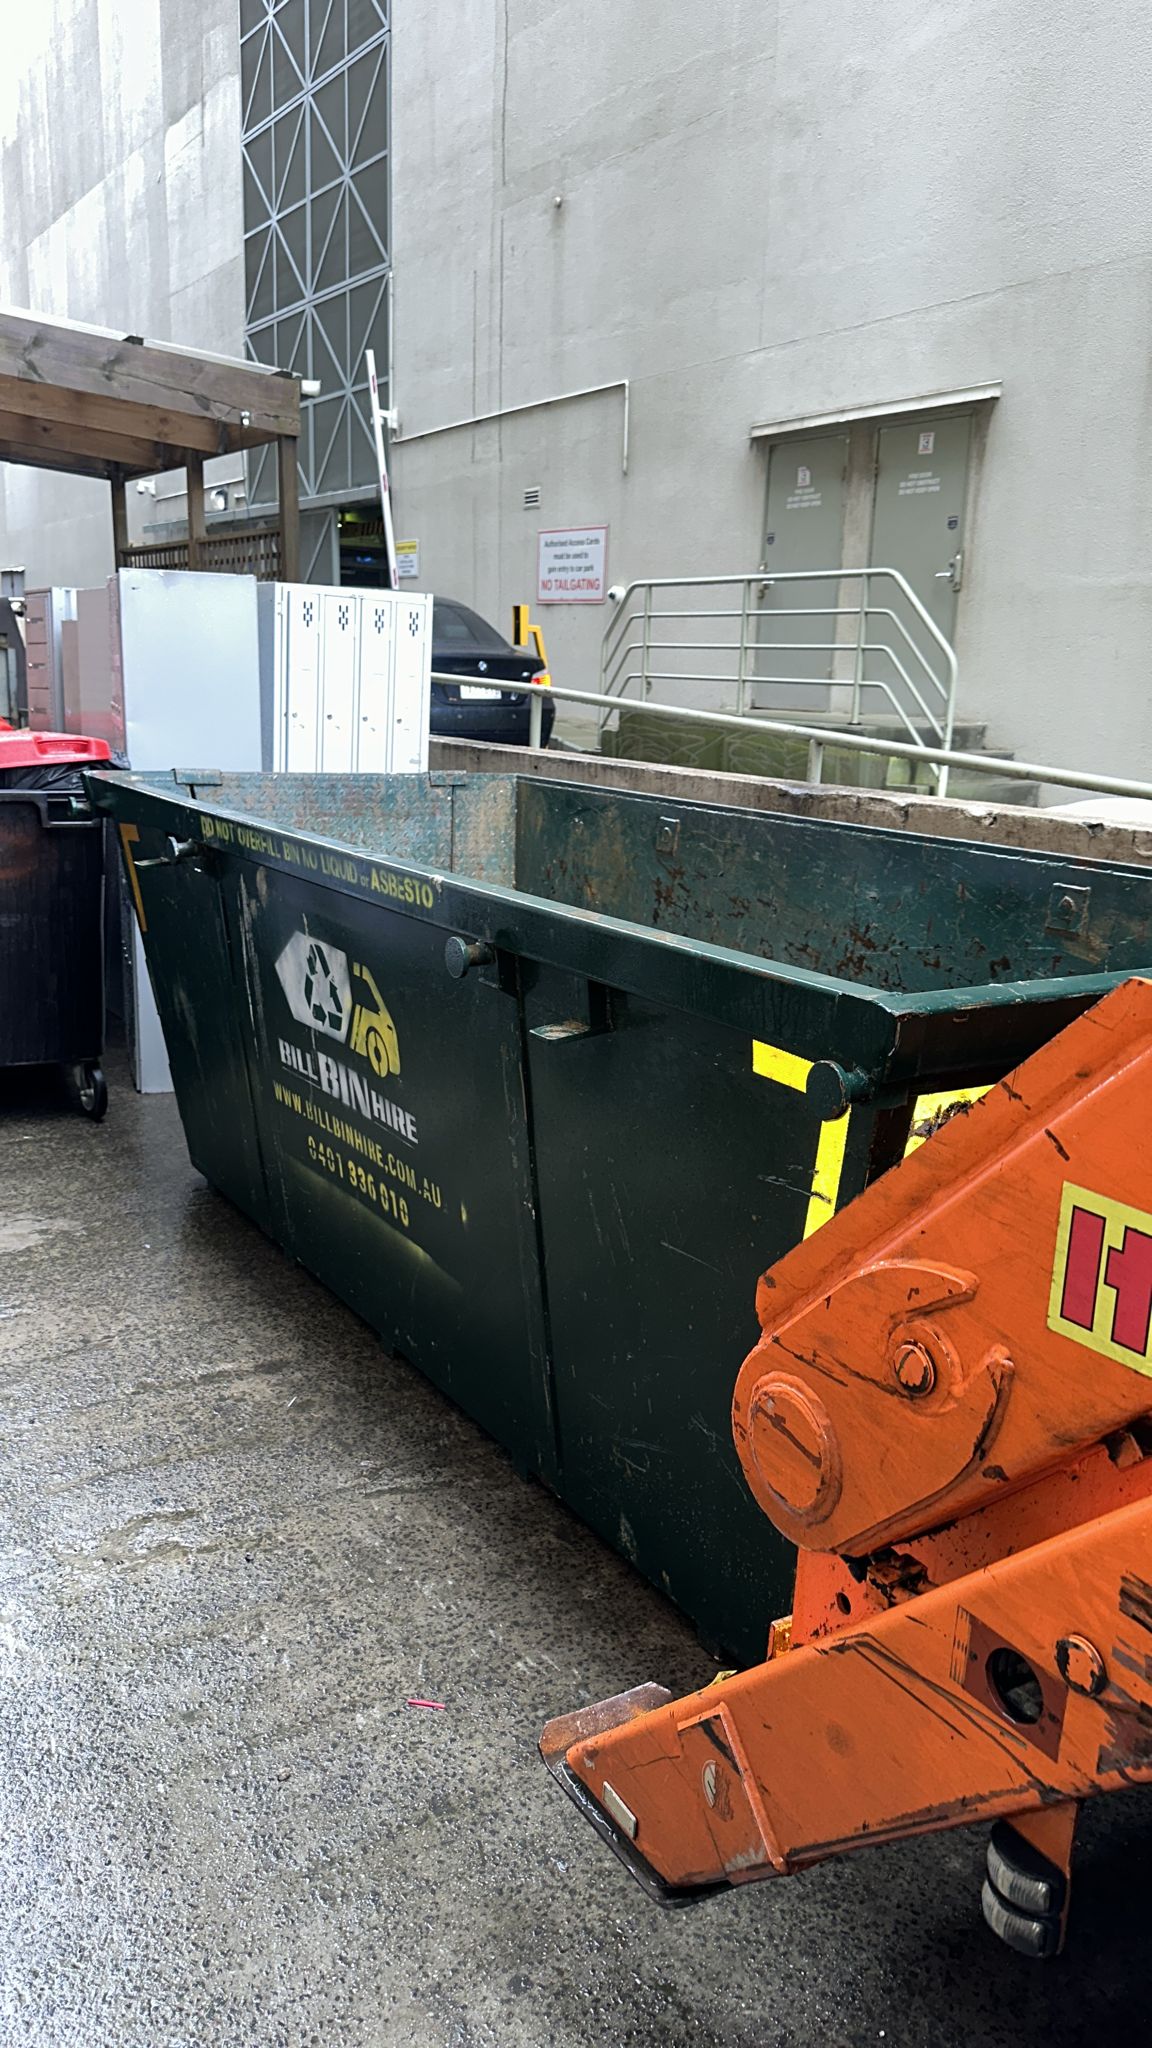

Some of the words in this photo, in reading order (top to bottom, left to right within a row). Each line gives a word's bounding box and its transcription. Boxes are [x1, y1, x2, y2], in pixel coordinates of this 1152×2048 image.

[541, 579, 552, 591] NO
[554, 578, 600, 591] TAILGATING
[215, 819, 234, 842] NOT
[283, 841, 300, 865] BIN
[301, 847, 318, 870] NO
[320, 853, 358, 884] LIQUID
[361, 875, 369, 887] or
[371, 867, 433, 909] ASBESTO
[307, 1135, 344, 1179] 0401
[379, 1182, 409, 1228] 010
